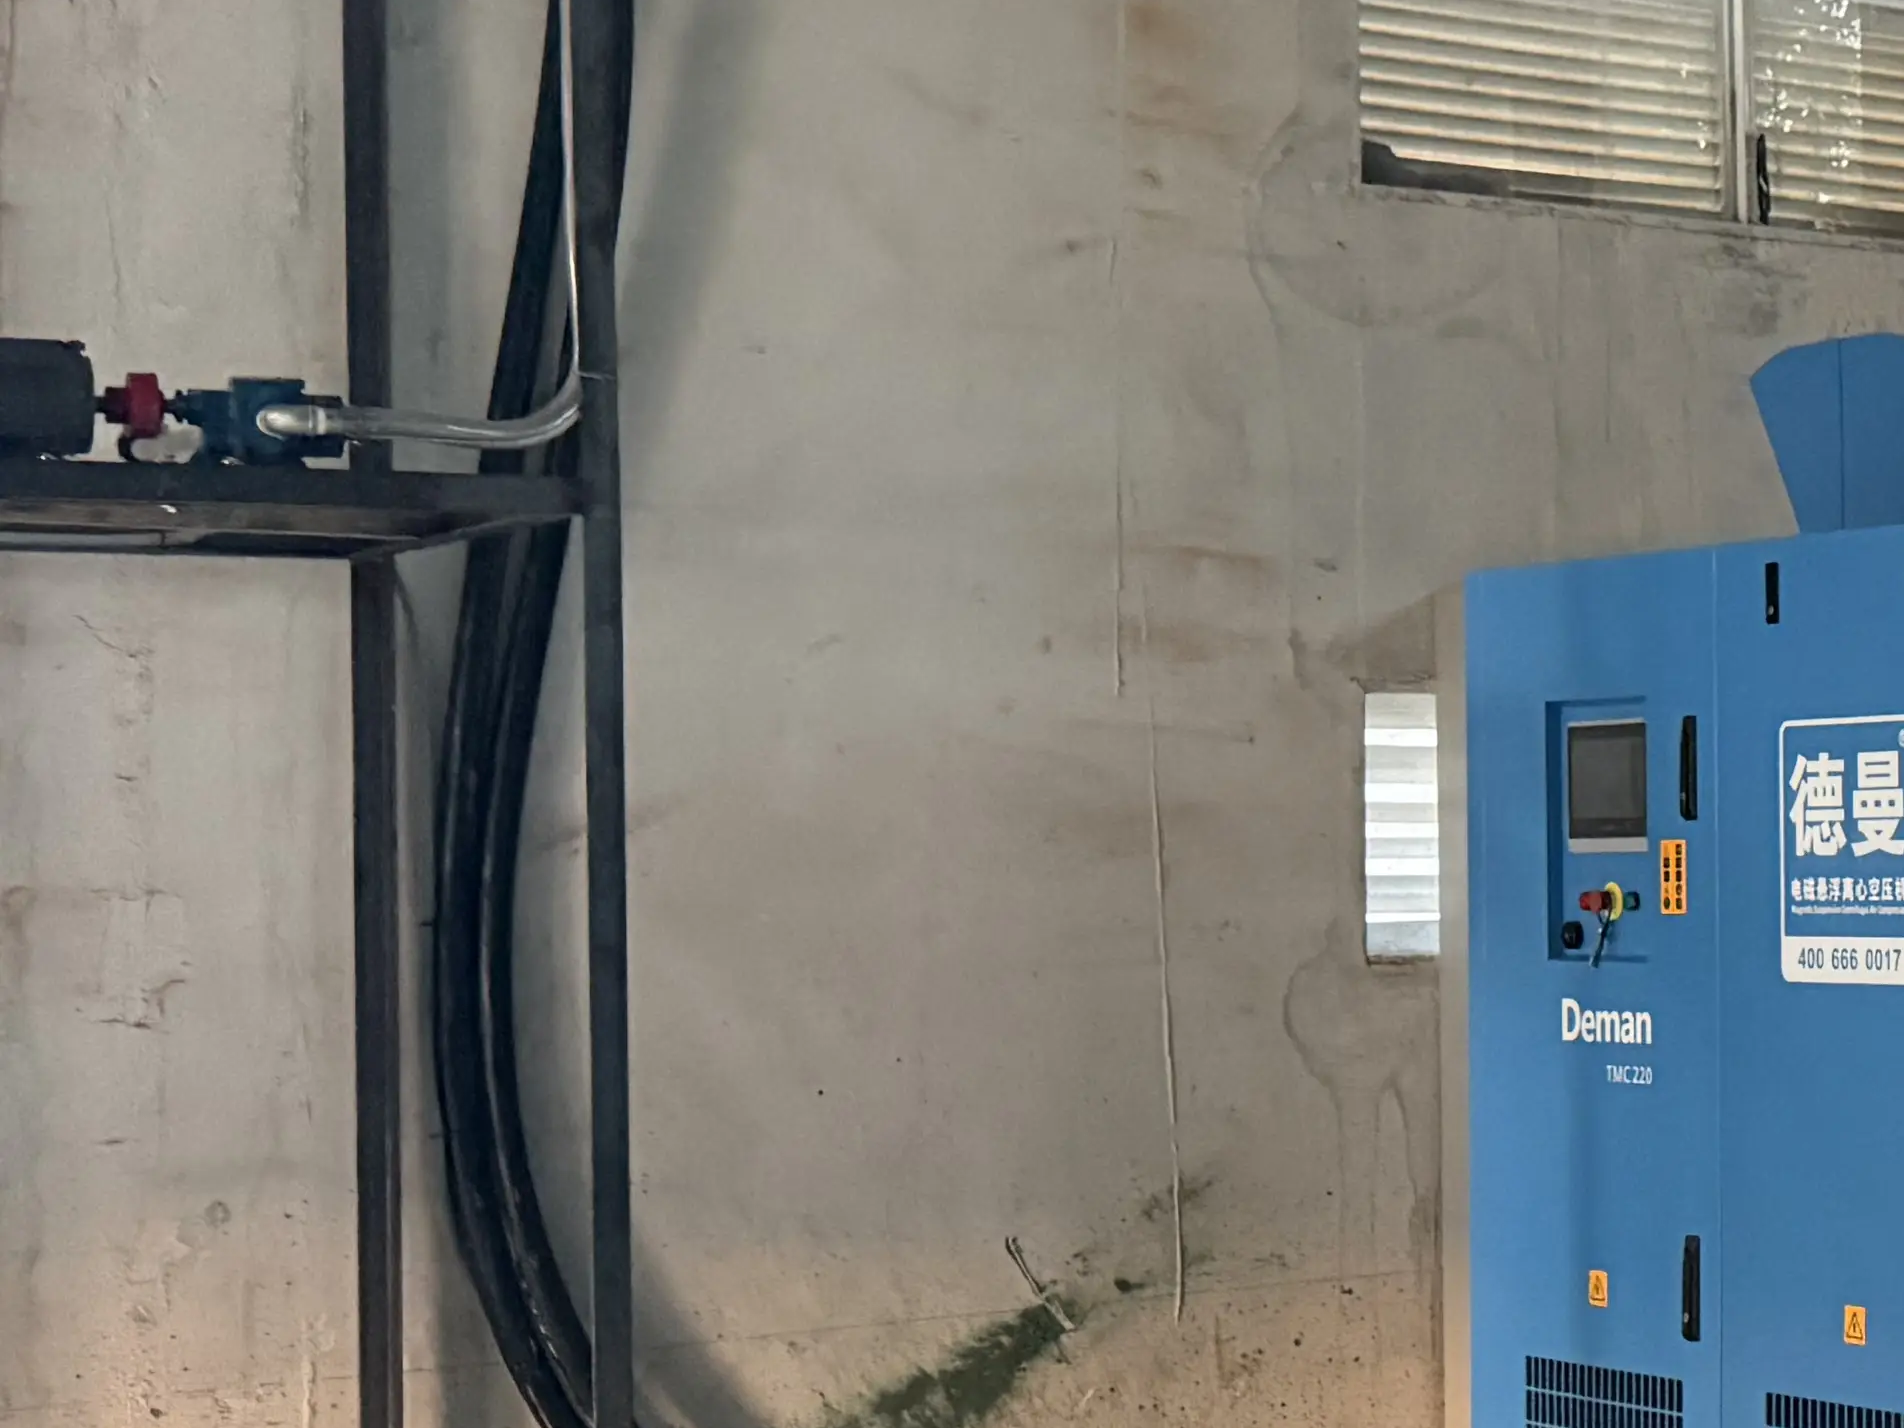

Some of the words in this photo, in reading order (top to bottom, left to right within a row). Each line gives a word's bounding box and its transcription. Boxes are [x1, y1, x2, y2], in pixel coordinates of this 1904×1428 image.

[1797, 947, 1825, 969] 400
[1831, 947, 1859, 970] 666
[1865, 948, 1902, 972] 0017
[1561, 997, 1653, 1045] Deman
